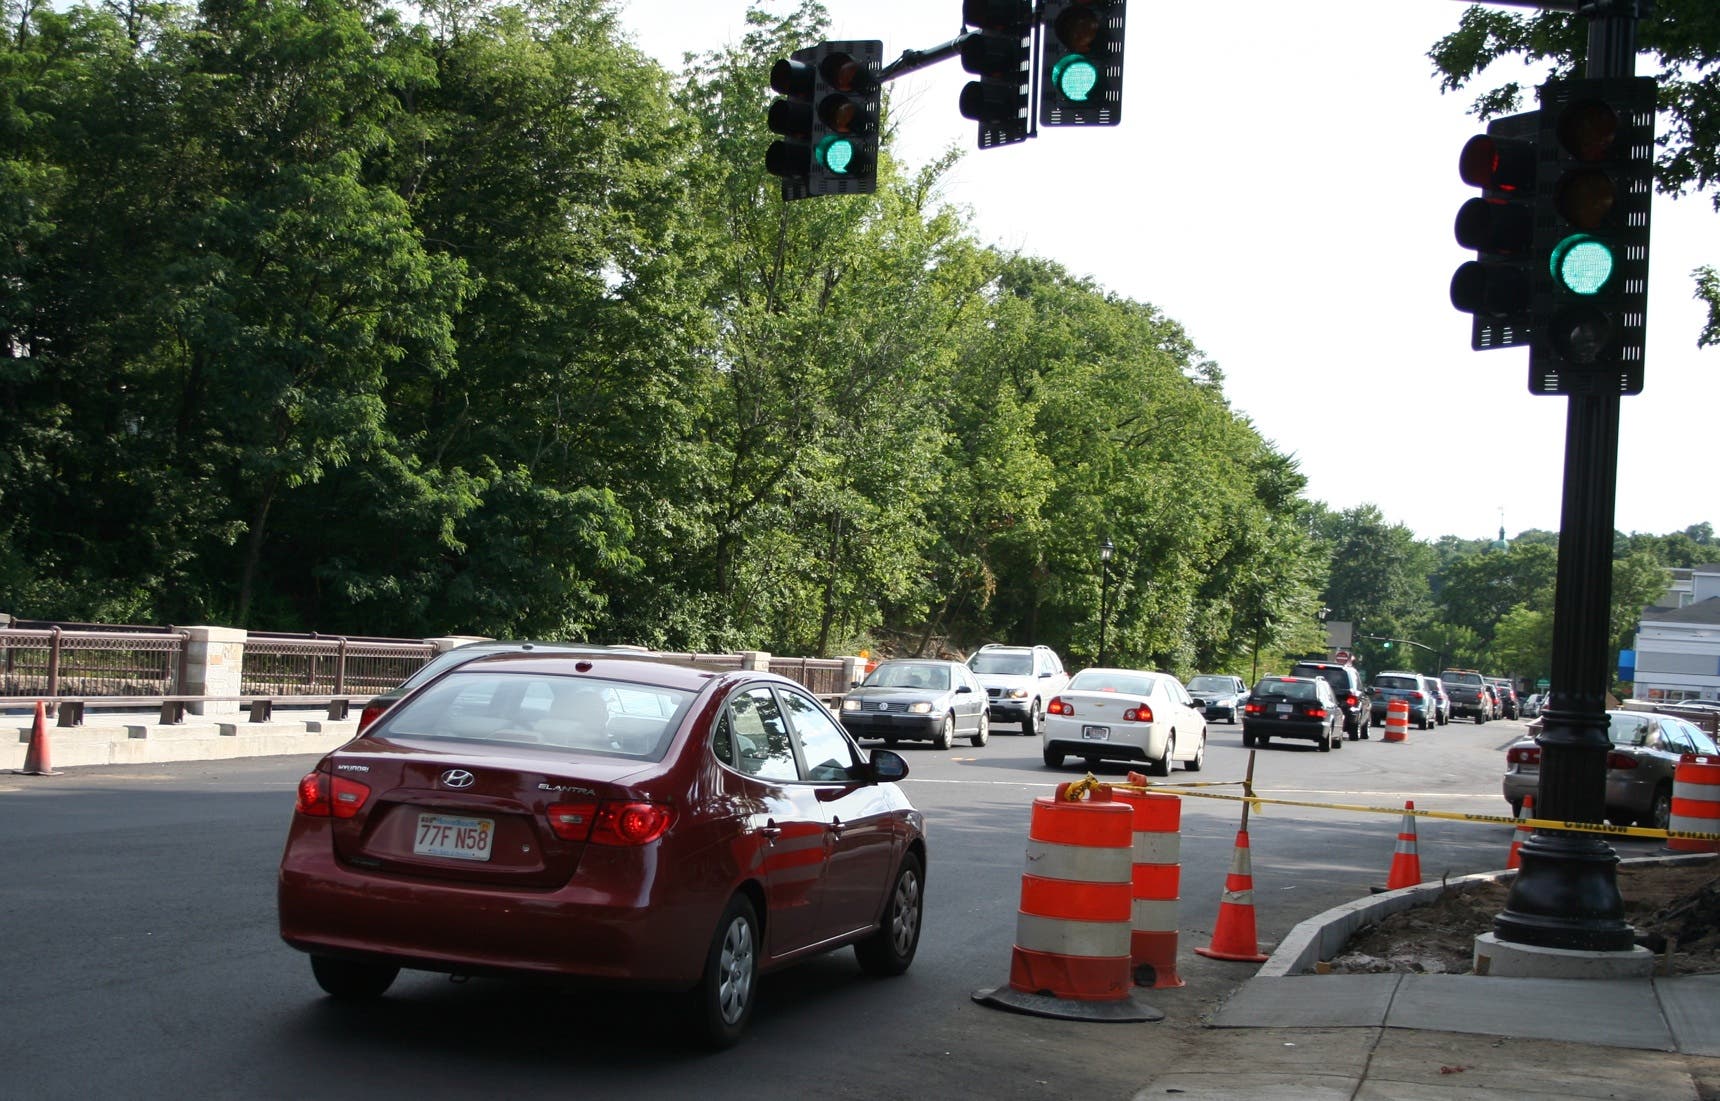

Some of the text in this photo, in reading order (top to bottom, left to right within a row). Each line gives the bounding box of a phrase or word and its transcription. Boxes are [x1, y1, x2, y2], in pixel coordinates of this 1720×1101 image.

[537, 783, 596, 796] ELANTRA
[419, 824, 488, 850] 77F N58
